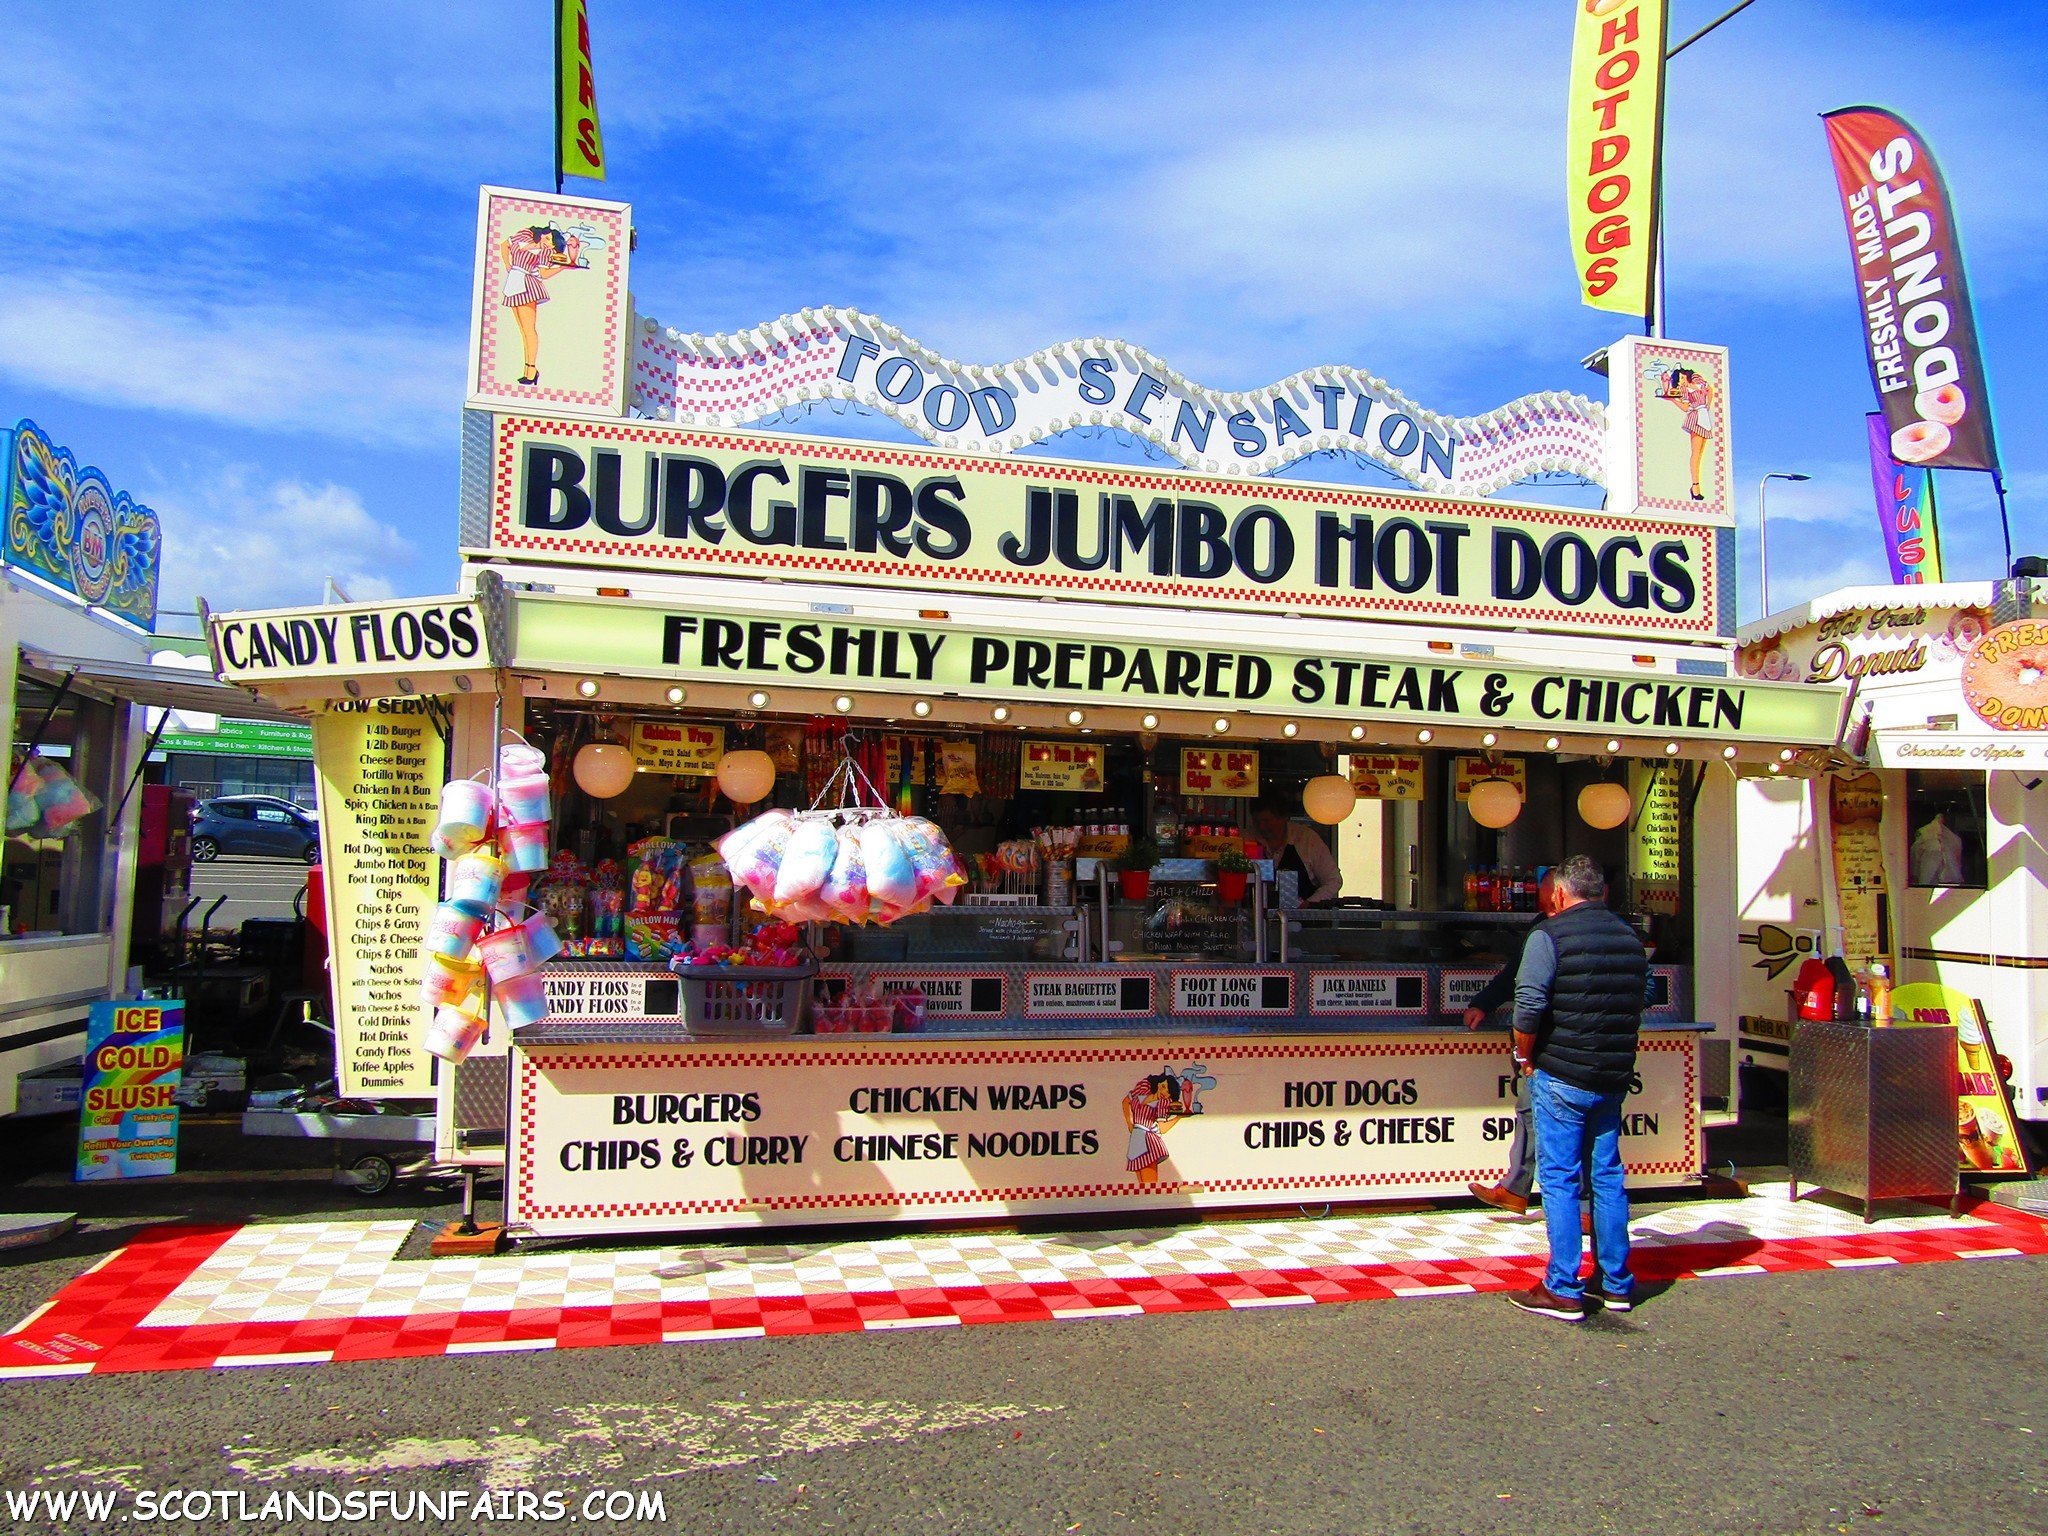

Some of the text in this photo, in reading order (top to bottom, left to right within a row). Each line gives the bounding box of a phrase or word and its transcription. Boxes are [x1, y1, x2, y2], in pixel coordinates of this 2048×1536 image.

[1869, 137, 1961, 394] DONUTS
[1848, 184, 1909, 394] FRESHLY MADE
[836, 334, 1455, 480] FOOD SENSATION
[521, 440, 1698, 614] BURGERS JUMBO HOT DOGS
[1893, 460, 1926, 584] LUS
[1817, 606, 1927, 643] Hot Fresh
[223, 605, 479, 670] CANDY FLOSS
[1804, 639, 1928, 684] Donuts
[661, 614, 1746, 731] FRESHLY PREPARED STEAK & CHICKEN
[260, 730, 291, 738] Furniture
[366, 725, 422, 738] 1/4lb Burger
[183, 739, 204, 747] Blinds
[258, 744, 285, 752] Kitchen
[366, 740, 422, 753] 1/2lb Burger
[1896, 742, 2024, 761] Chocolate Apples
[359, 754, 426, 767] Cheese Burger
[1212, 752, 1222, 770] &
[1641, 758, 1669, 769] NOW
[362, 769, 423, 782] Tortilla Wraps
[1187, 771, 1211, 791] Chips
[353, 784, 431, 795] Chicken In A Bun
[344, 799, 369, 811] Spicy
[372, 799, 407, 810] Chicken
[1650, 801, 1671, 809] Cheese
[356, 814, 395, 826] King Rib
[1651, 812, 1671, 821] Tortilla
[362, 829, 389, 839] Steak
[1647, 824, 1669, 832] Chicken
[637, 842, 676, 850] MALLOW
[1641, 836, 1657, 846] Spicy
[344, 844, 435, 856] Hot Dog Cheese
[1649, 848, 1674, 858] King Rib
[354, 858, 426, 871] Jumbo Hot Dog
[1653, 860, 1671, 868] Steak
[348, 874, 430, 886] Foot Long Hotdog
[1642, 872, 1653, 880] Hot
[376, 889, 402, 901] Chips
[1147, 887, 1175, 897] SALT
[357, 904, 420, 916] Chips & Curry
[355, 919, 420, 931] Chips & Gravy
[629, 915, 680, 927] MALLOW MAN
[995, 917, 1021, 928] Nachos
[351, 933, 423, 946] Chips & Cheese
[1131, 930, 1163, 939] CHICKEN
[356, 948, 418, 961] Chips & Chilli
[369, 964, 403, 974] Nachos
[403, 978, 422, 986] Salsa
[589, 981, 629, 995] FLOSS
[920, 981, 962, 996] SHAKE
[1181, 978, 1257, 991] FOOT LONG
[1323, 979, 1386, 993] JACK DANIELS
[1449, 979, 1487, 992] GOURMET
[368, 990, 402, 1000] Nachos
[1033, 983, 1117, 996] STEAK BAGUETTES
[548, 999, 628, 1013] ANDY FLOSS
[1187, 993, 1250, 1007] HOT DOG
[401, 1004, 420, 1012] Salsa
[115, 1008, 161, 1032] ICE
[358, 1016, 410, 1026] Cold Drinks
[359, 1031, 408, 1042] Hot Drinks
[98, 1046, 171, 1071] COLD
[355, 1046, 411, 1059] Candy Floss
[352, 1062, 414, 1074] Toffee Apples
[361, 1077, 404, 1087] Dummies
[1958, 1072, 1997, 1096] AKE
[87, 1084, 177, 1111] SLUSH
[850, 1083, 1087, 1114] CHICKEN WRAPS
[1284, 1078, 1418, 1108] HOT DOGS
[613, 1092, 762, 1124] BURGERS
[94, 1113, 176, 1124] Cup Twisty Cup
[1244, 1116, 1455, 1149] CHIPS & CHEESE
[83, 1138, 175, 1150] Refill Your Own Cup
[833, 1129, 1099, 1162] CHINESE NOODLES
[92, 1151, 174, 1164] Cup Twisty Cup
[560, 1135, 808, 1172] CHIPS & CURRY
[13, 1339, 73, 1363] SENSATION
[44, 1340, 77, 1353] FOOD
